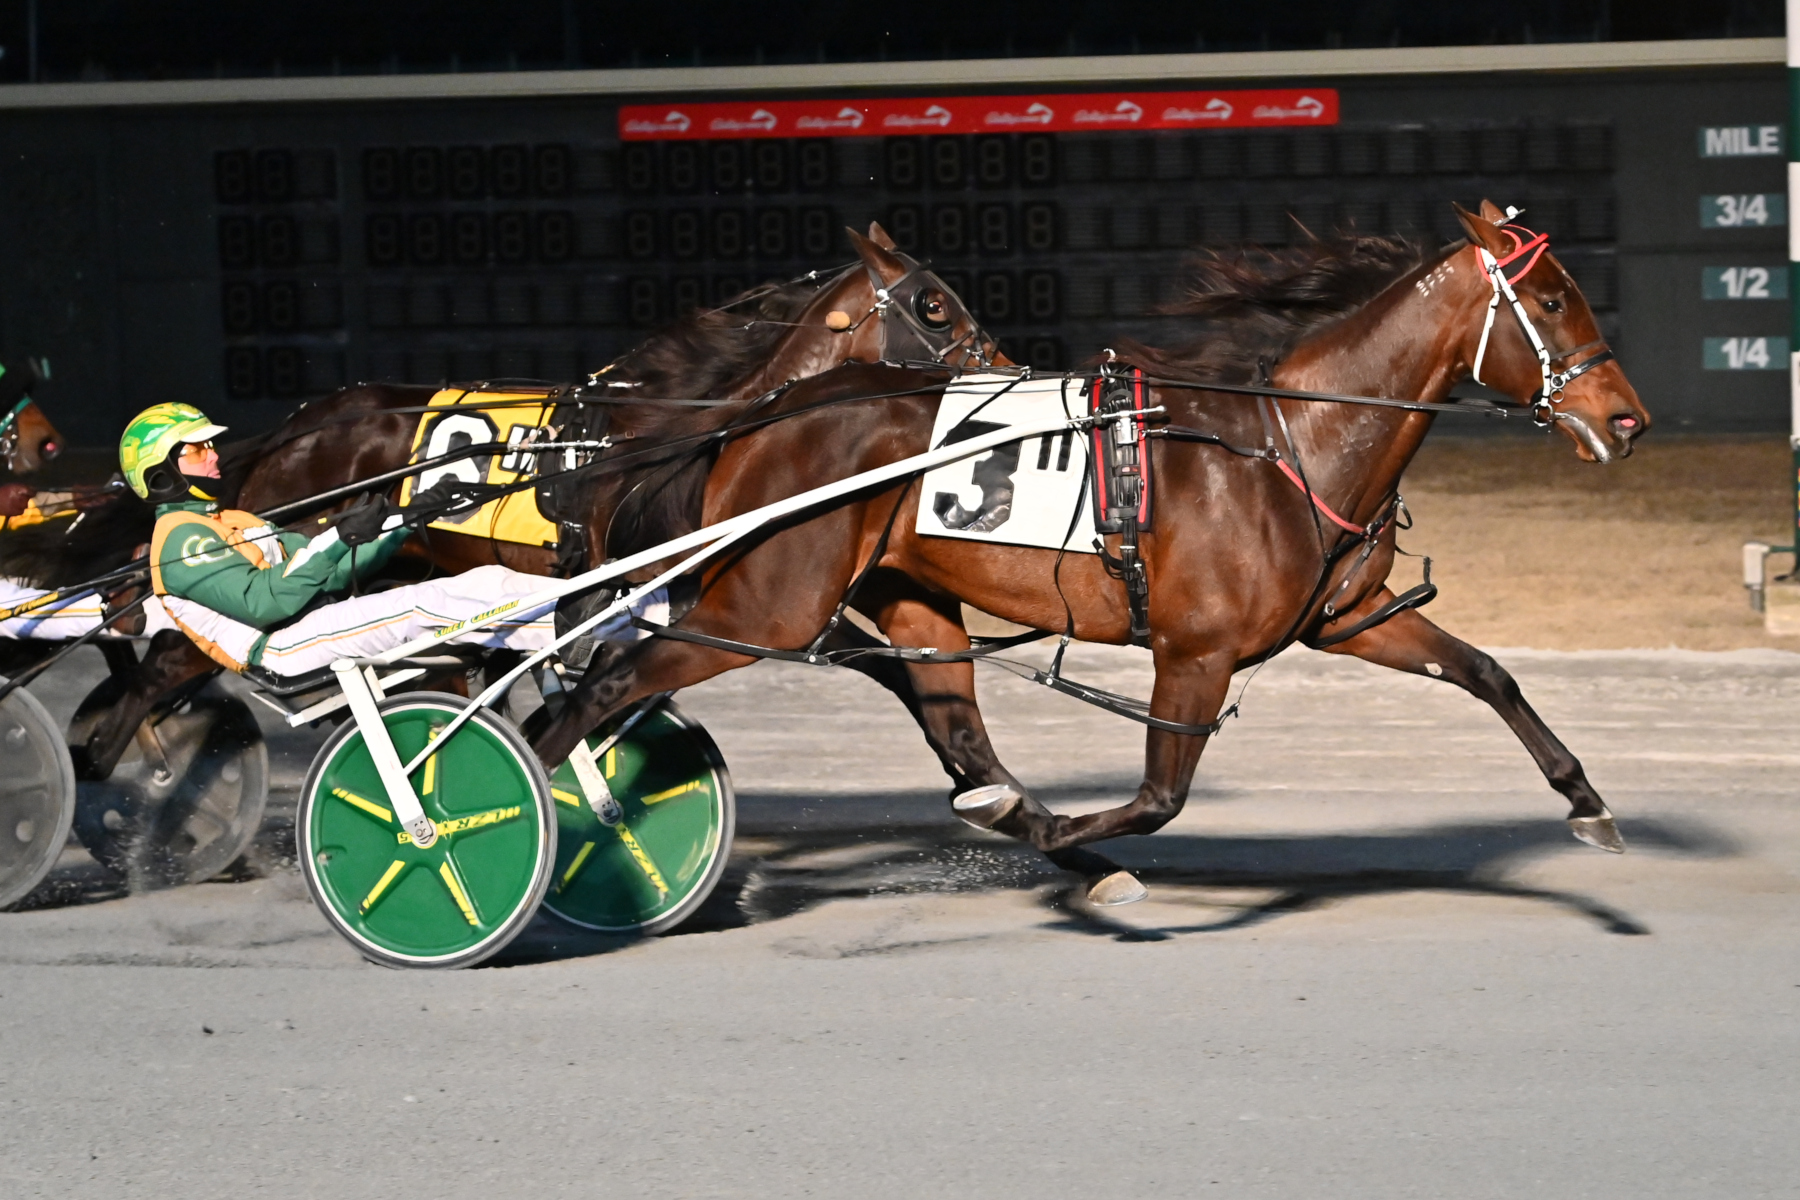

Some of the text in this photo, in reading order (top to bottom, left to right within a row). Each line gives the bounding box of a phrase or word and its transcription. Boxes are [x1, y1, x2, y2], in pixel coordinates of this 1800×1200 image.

[1705, 126, 1780, 155] MILE
[1715, 195, 1768, 226] 3/4
[1720, 267, 1769, 298] 1/2
[1721, 337, 1770, 369] 1/4
[932, 419, 1023, 533] 3
[470, 599, 520, 624] CALLAHAN
